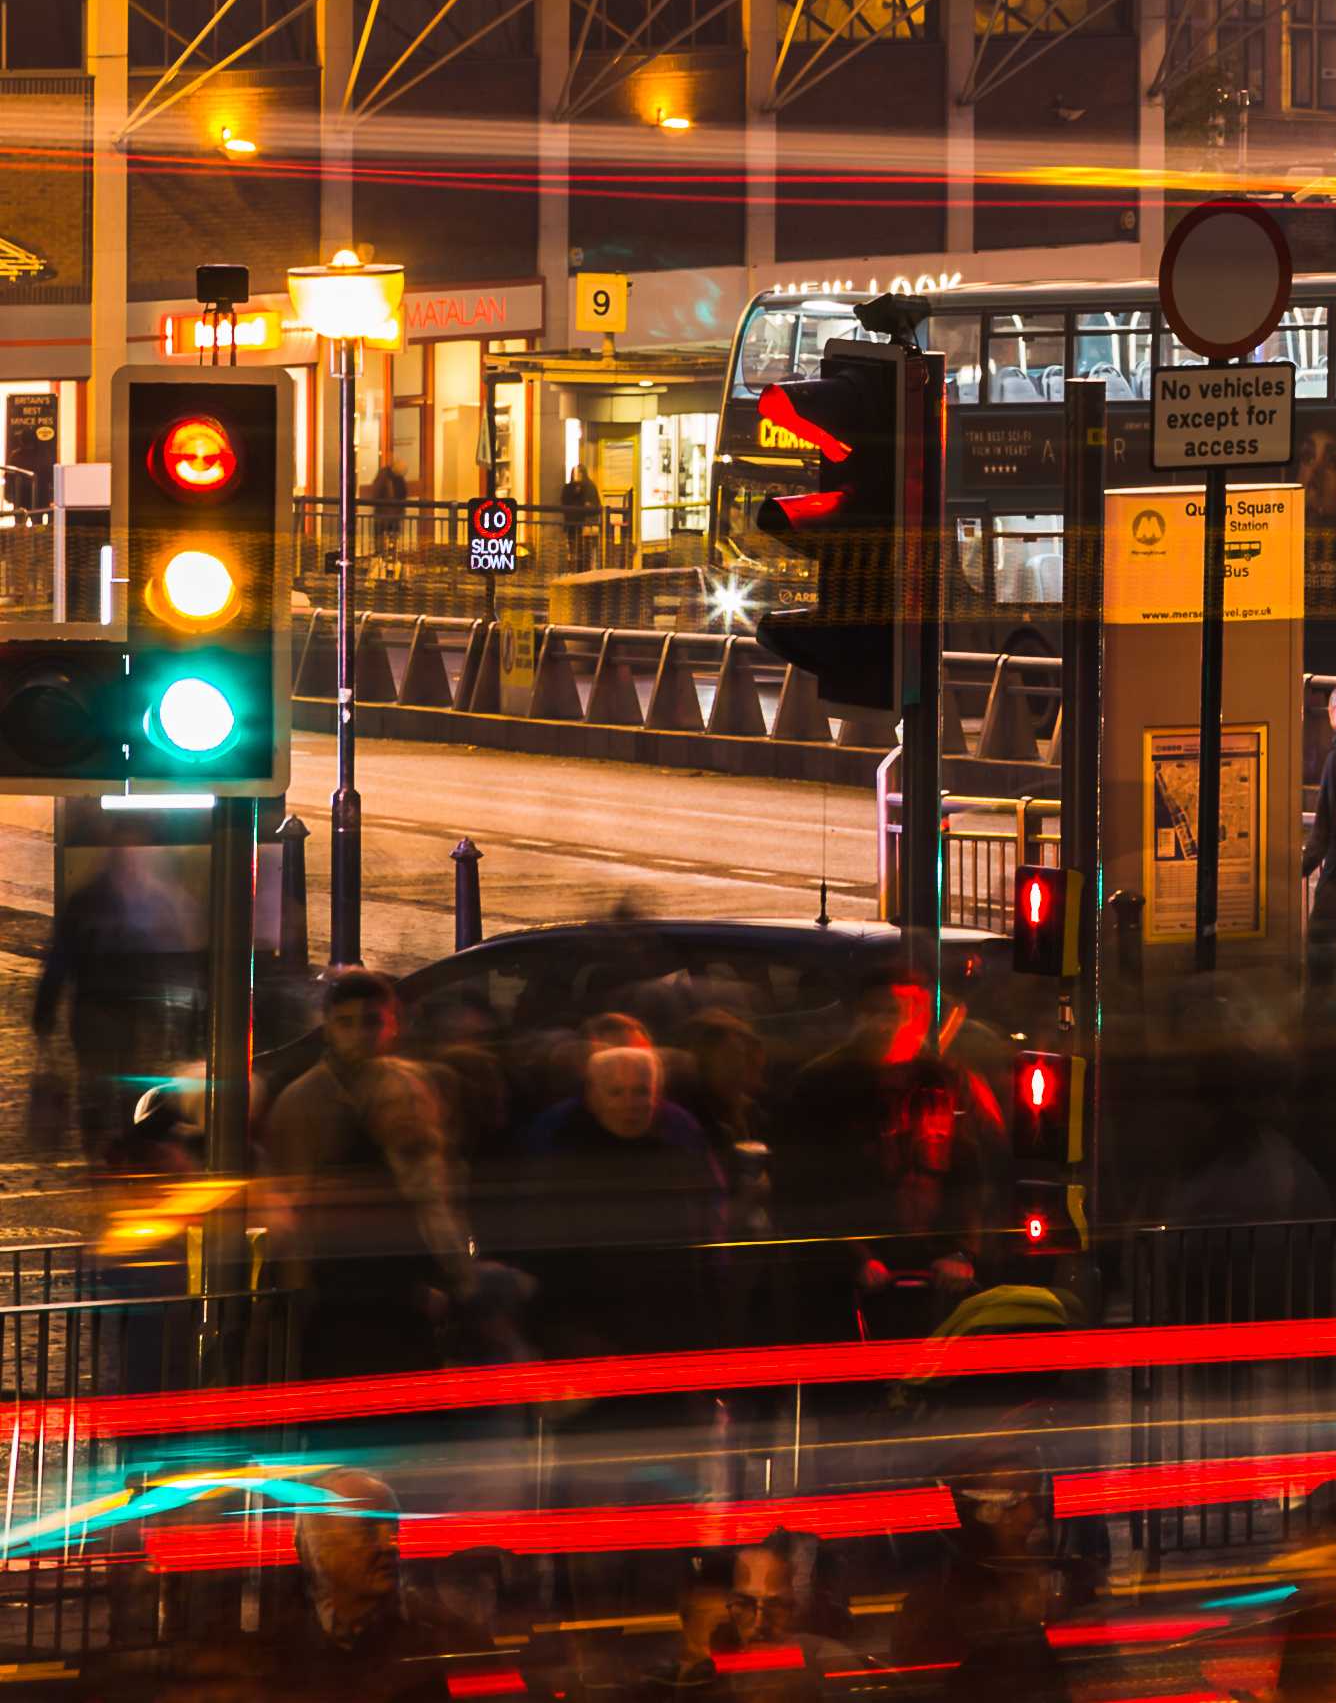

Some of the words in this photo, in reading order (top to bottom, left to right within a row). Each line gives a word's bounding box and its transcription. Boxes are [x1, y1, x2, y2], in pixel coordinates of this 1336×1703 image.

[593, 290, 610, 316] 9
[406, 296, 506, 329] MATALAN
[1161, 380, 1191, 400] No
[1199, 376, 1286, 399] vehicles
[22, 407, 41, 415] BEST
[1166, 407, 1239, 431] except
[1247, 406, 1277, 425] for
[1184, 438, 1259, 457] access
[1185, 502, 1233, 516] Qun
[1237, 501, 1285, 517] Square
[483, 510, 507, 529] 10
[1230, 520, 1269, 532] Station
[471, 538, 513, 554] SLOW
[470, 554, 515, 570] DOWN
[1225, 564, 1249, 578] Bus
[794, 592, 819, 603] ARR
